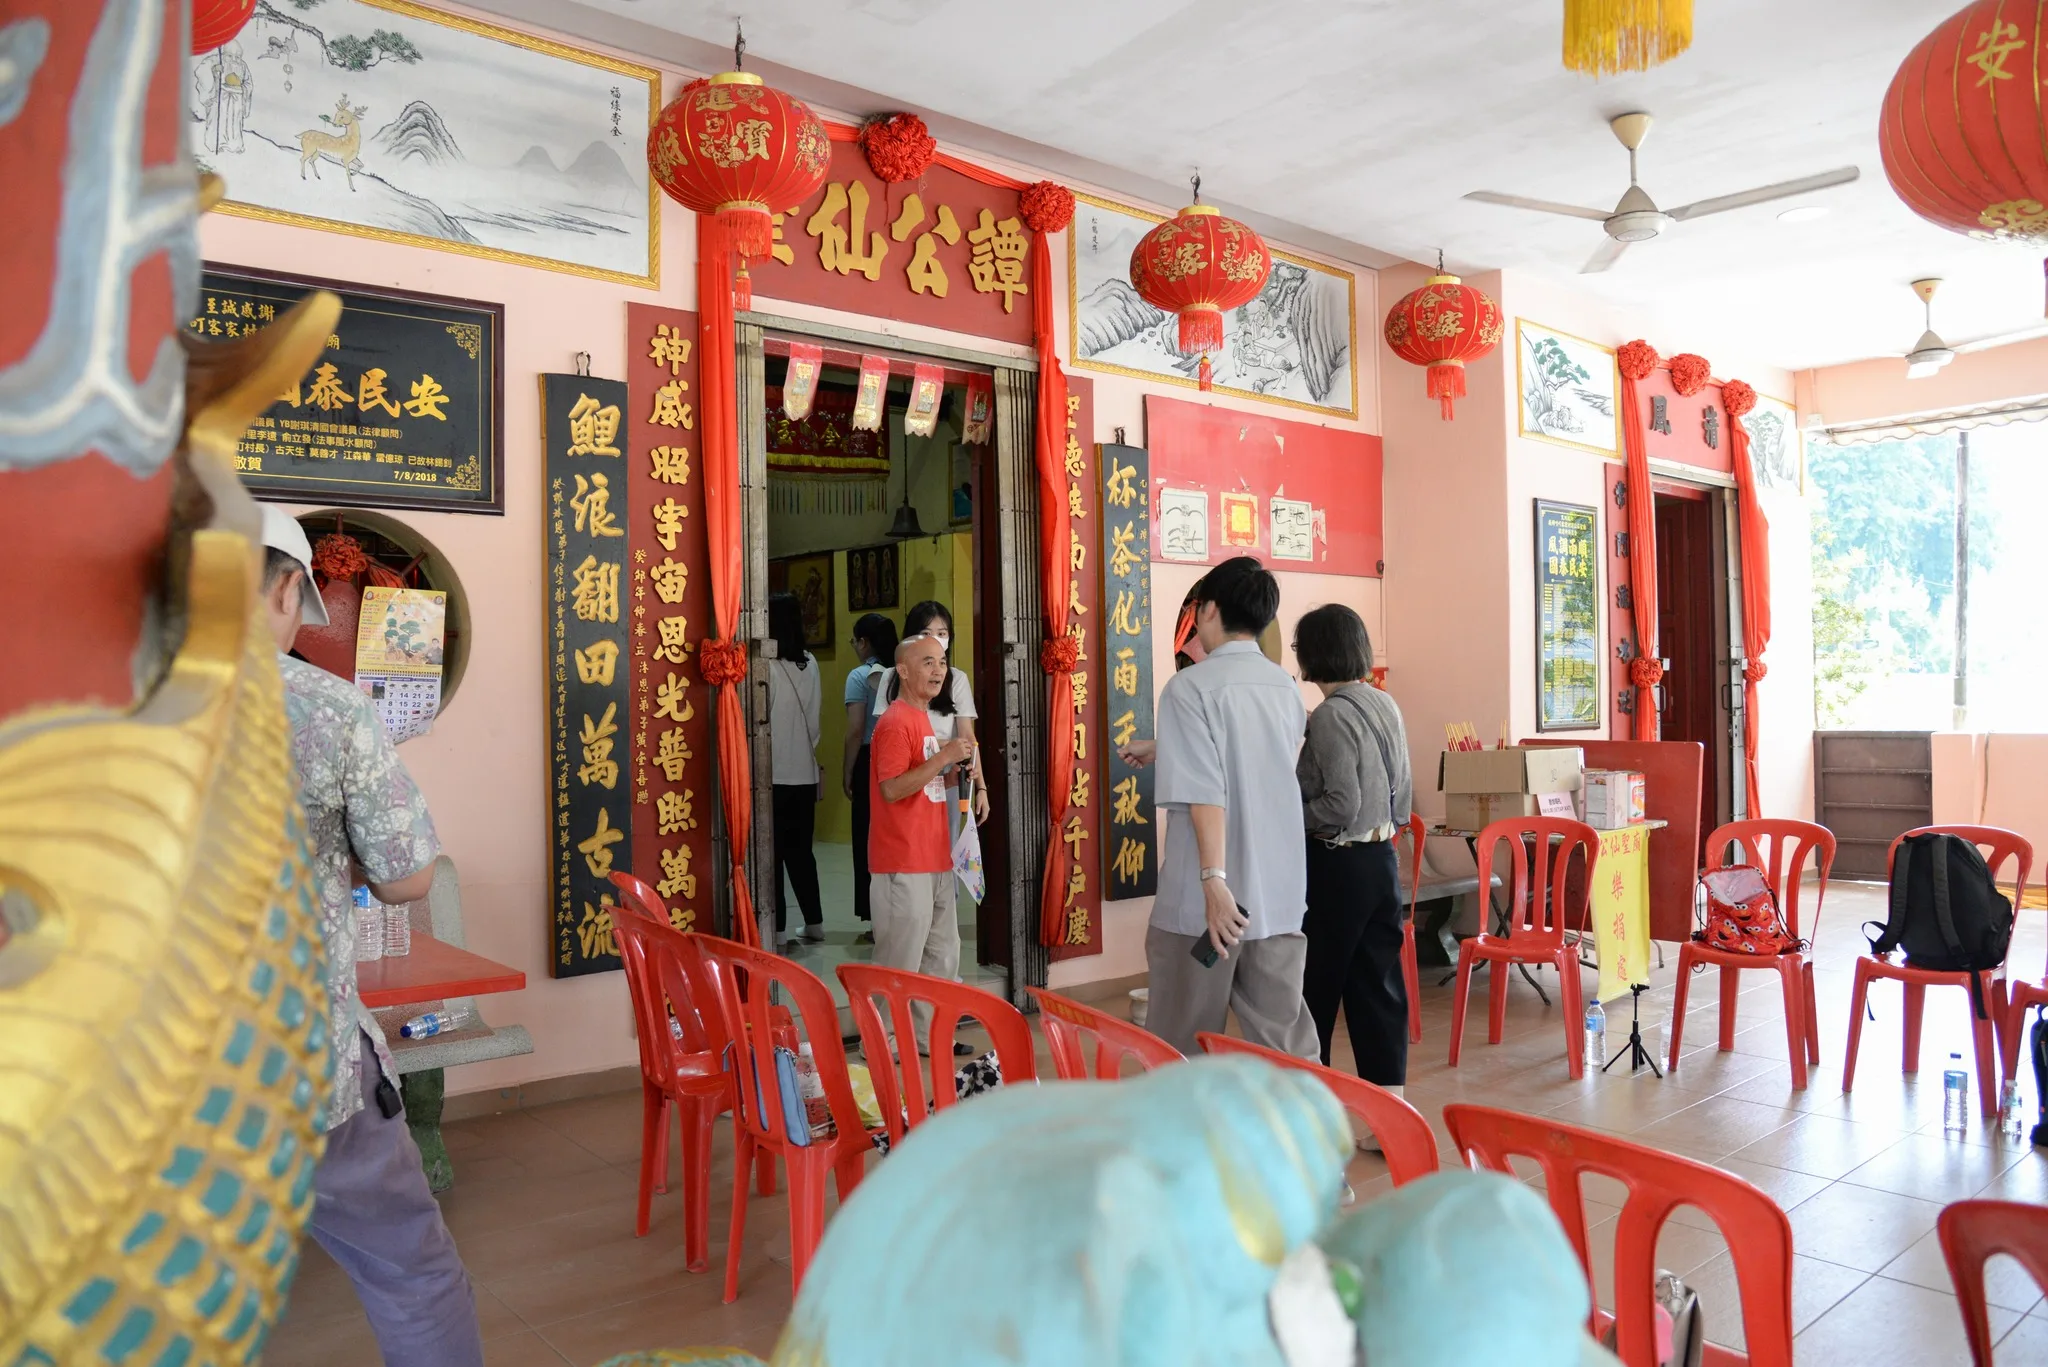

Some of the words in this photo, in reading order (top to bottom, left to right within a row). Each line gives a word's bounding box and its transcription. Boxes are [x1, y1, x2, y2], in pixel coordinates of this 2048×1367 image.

[1966, 18, 2027, 87] 安
[206, 297, 276, 322] 至誠感謝
[275, 362, 450, 421] 泰民安
[393, 470, 438, 482] 7/8/2018
